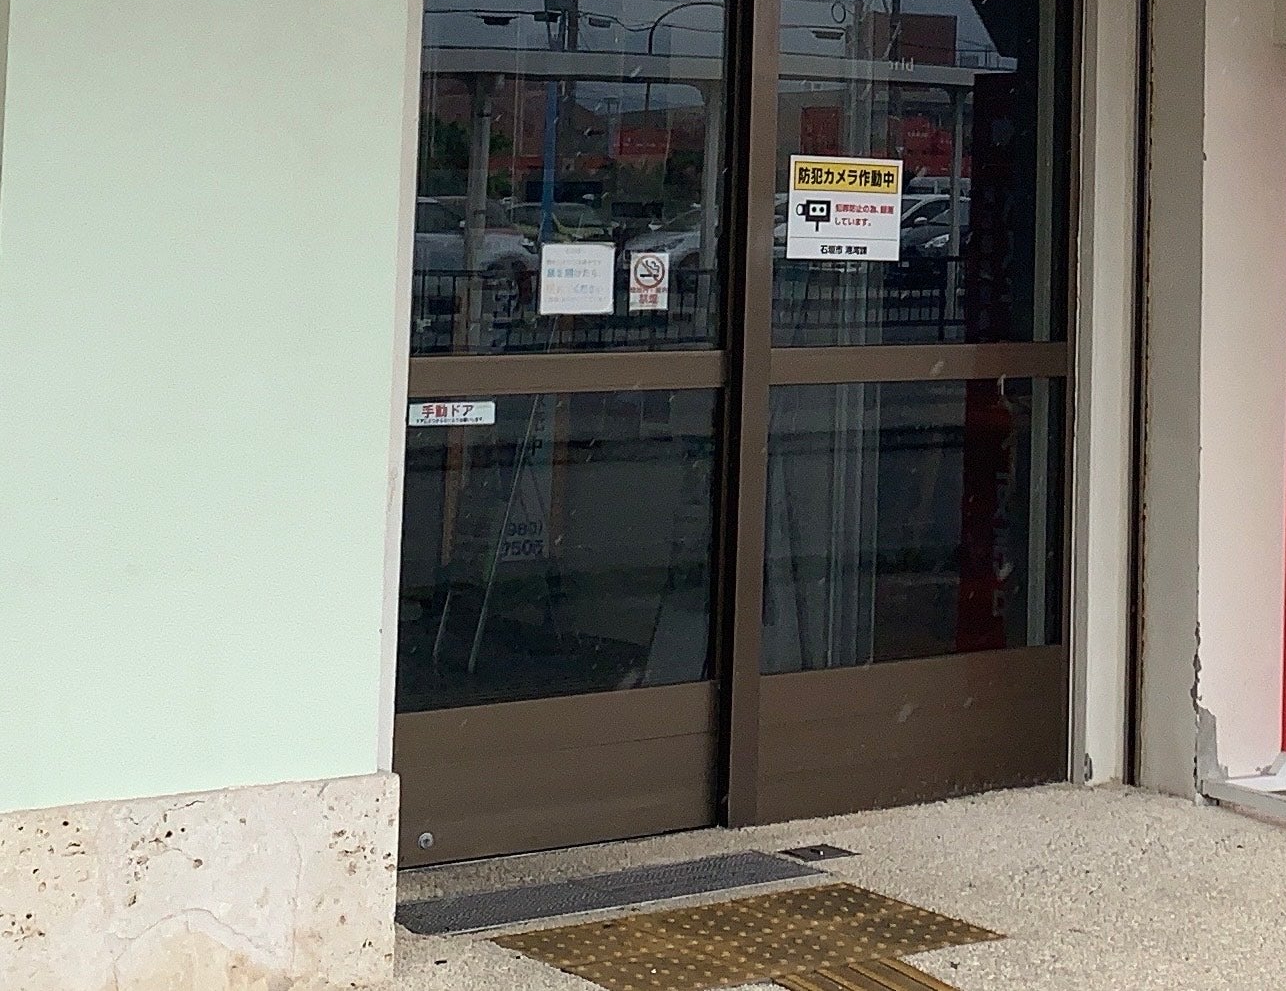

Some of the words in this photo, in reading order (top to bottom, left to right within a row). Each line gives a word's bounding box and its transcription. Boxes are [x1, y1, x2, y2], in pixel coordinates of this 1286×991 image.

[798, 167, 895, 188] 防犯カメラ作動中
[835, 218, 871, 227] しています。
[422, 404, 474, 418] 手動ドア
